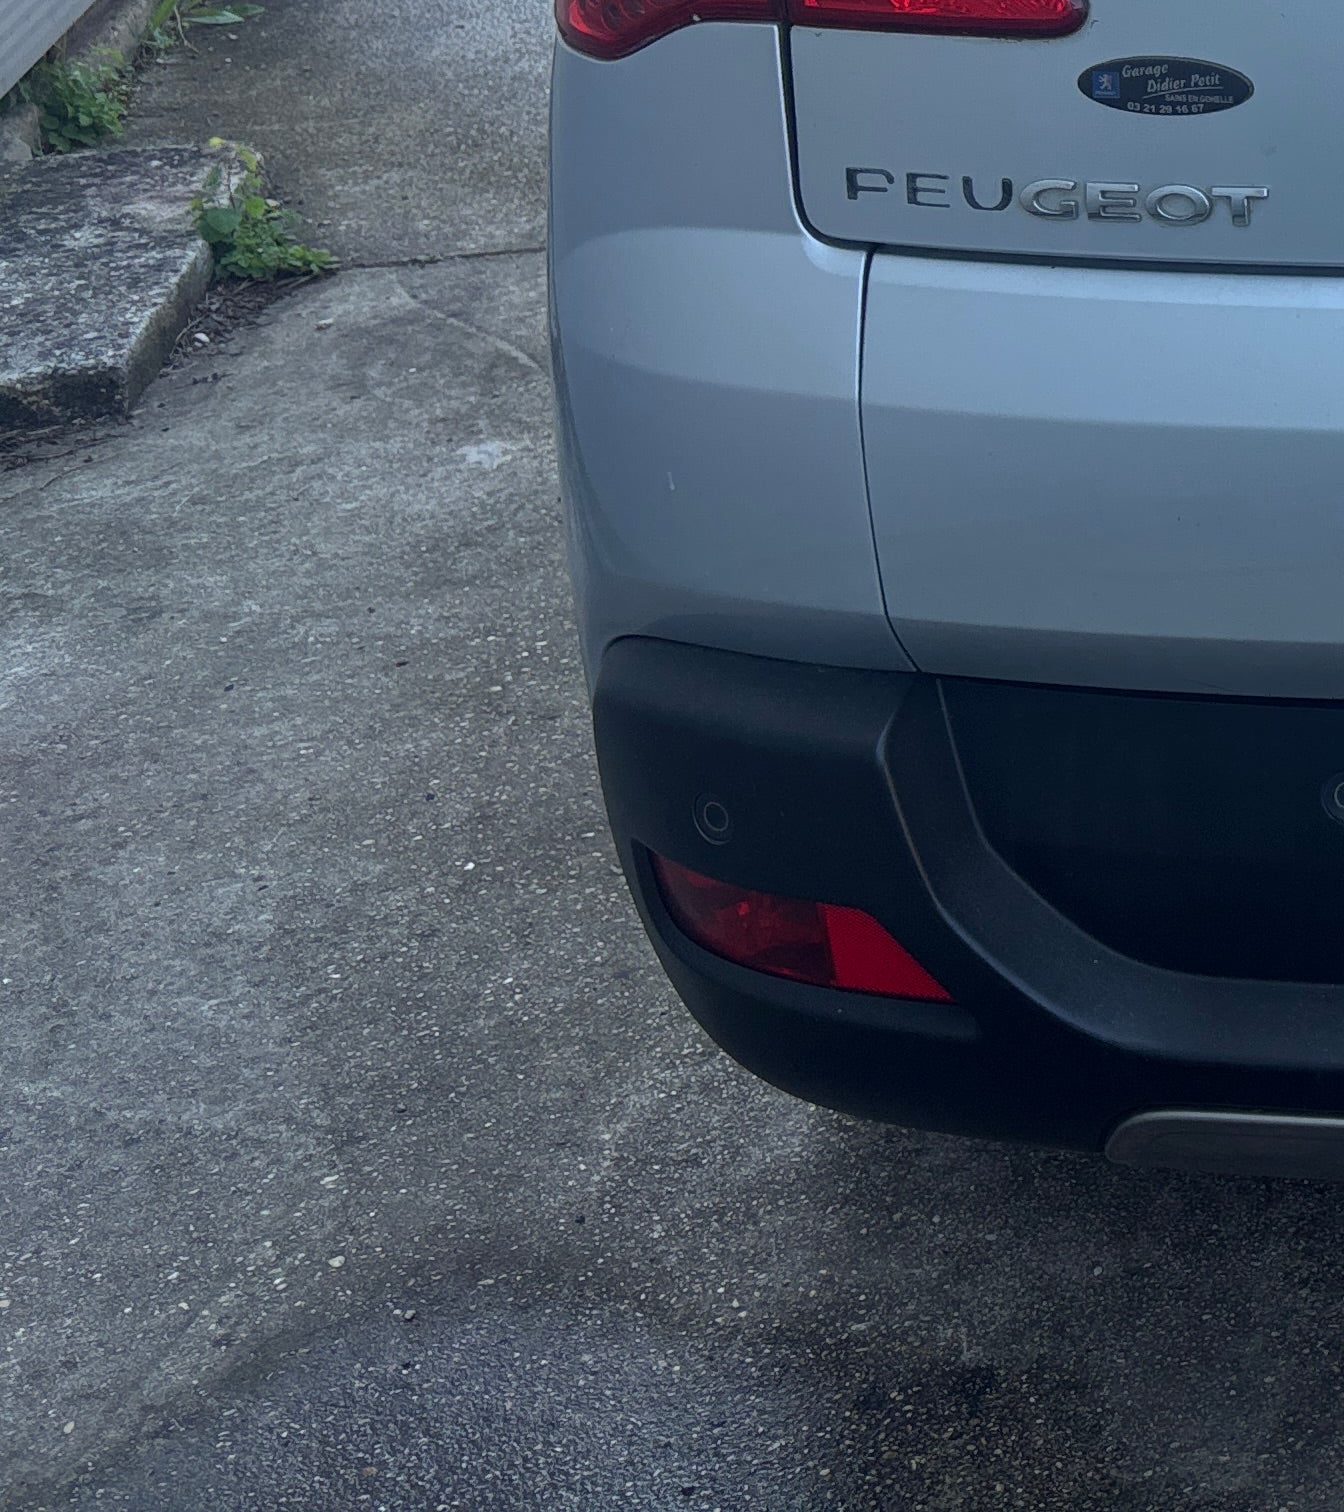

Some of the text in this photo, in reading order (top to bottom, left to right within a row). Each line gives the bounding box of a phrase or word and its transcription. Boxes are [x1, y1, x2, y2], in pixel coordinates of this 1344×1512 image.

[1122, 64, 1169, 78] Garage
[1147, 72, 1220, 92] Didier Petit
[1127, 101, 1141, 111] 03
[1143, 103, 1156, 112] 21
[845, 166, 1269, 227] PEUGEOT
